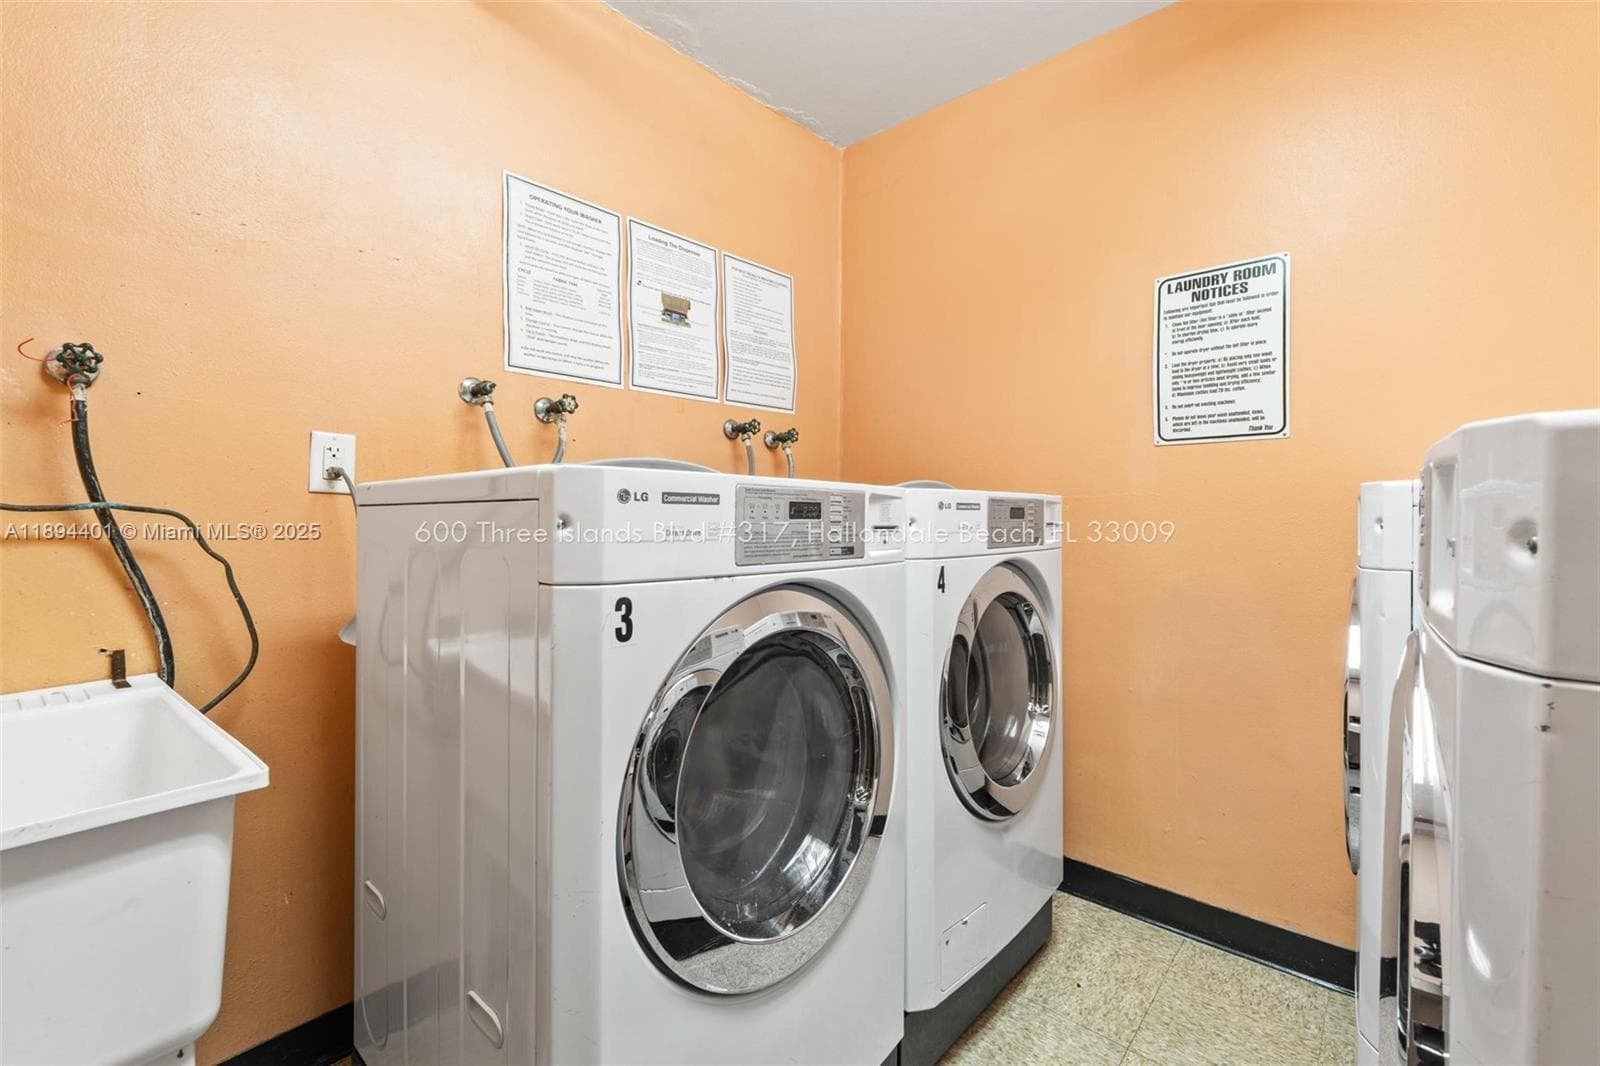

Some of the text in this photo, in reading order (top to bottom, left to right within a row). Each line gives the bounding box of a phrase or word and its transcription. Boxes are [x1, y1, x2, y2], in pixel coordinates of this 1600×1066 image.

[529, 193, 602, 225] OPERATING YOUR WASHER
[648, 234, 668, 247] Loading
[669, 241, 677, 249] The
[518, 267, 531, 275] CYCLE
[1167, 263, 1276, 294] LAUNDRY ROOM
[1191, 282, 1248, 302] NOTICES
[634, 492, 648, 502] LG
[664, 494, 720, 504] Commercial Washer
[944, 502, 952, 510] LG
[937, 566, 946, 594] 4
[614, 596, 634, 642] 3
